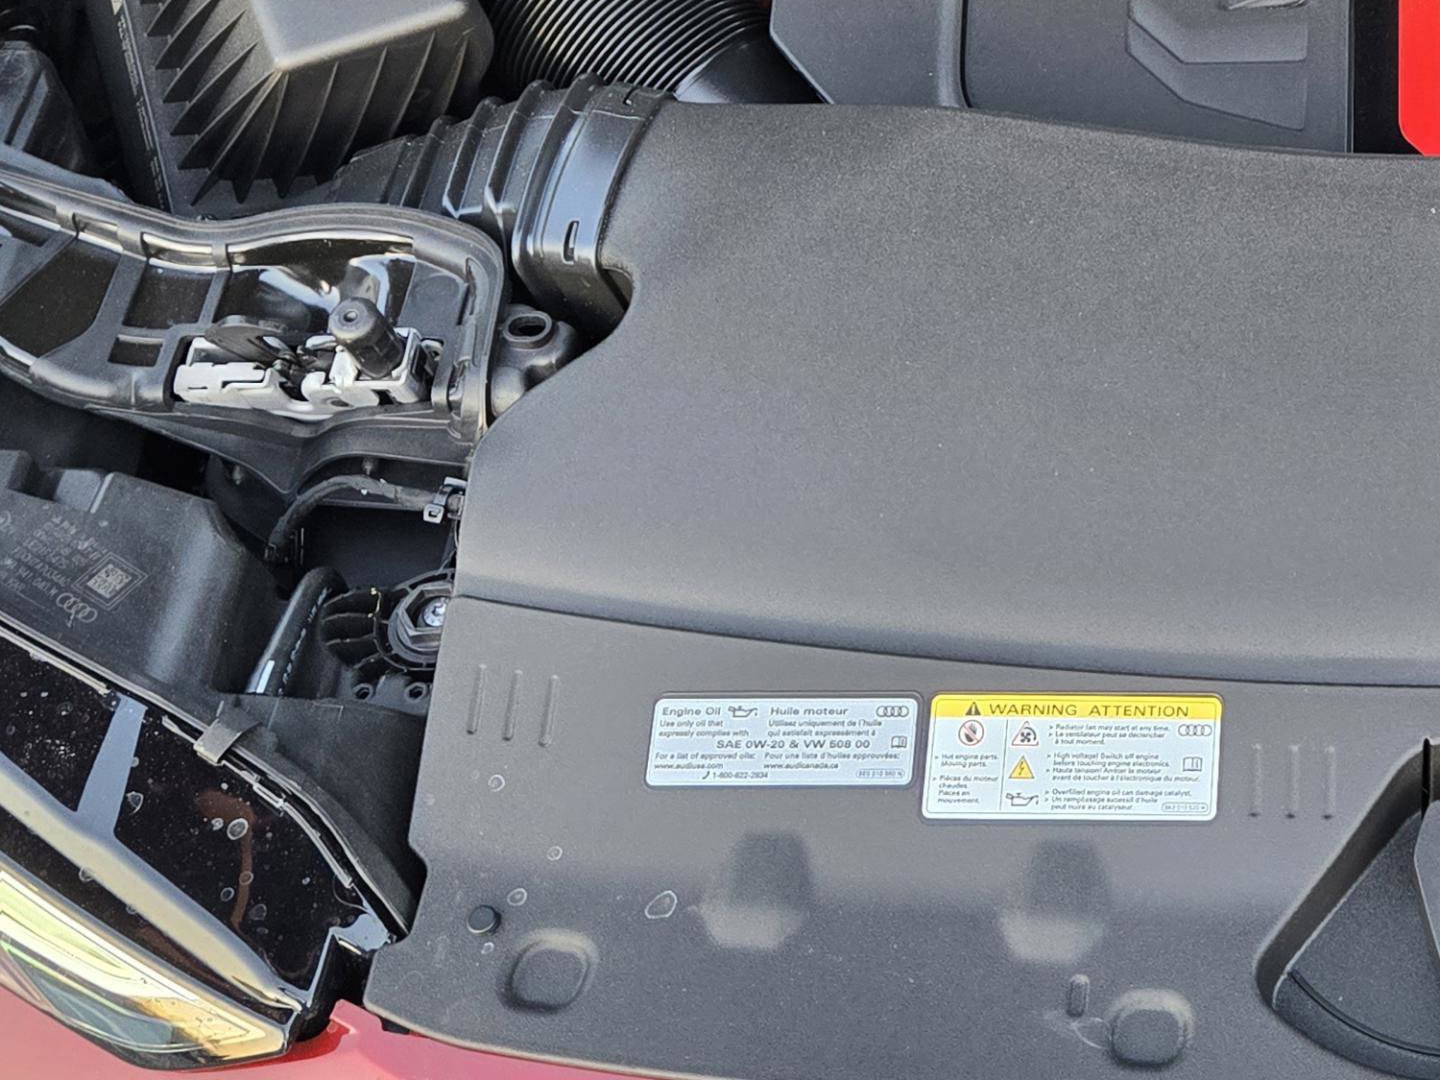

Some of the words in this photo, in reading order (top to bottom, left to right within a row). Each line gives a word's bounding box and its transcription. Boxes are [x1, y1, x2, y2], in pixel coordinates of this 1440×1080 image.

[662, 707, 701, 718] Engine
[705, 706, 721, 716] Oil
[770, 707, 800, 715] Huile
[803, 707, 848, 715] moteur
[989, 703, 1077, 716] WARNING
[1088, 704, 1190, 717] ATTENTION
[677, 720, 694, 728] only
[798, 720, 845, 729] uniquement
[658, 730, 694, 738] expressly
[696, 730, 730, 738] complies
[767, 729, 780, 738] qui
[716, 740, 742, 749] SAE
[745, 740, 785, 749] 0W-20
[789, 740, 799, 749] &
[804, 740, 826, 749] VW
[829, 740, 851, 749] 508
[855, 740, 870, 749] 00
[701, 752, 738, 760] approved
